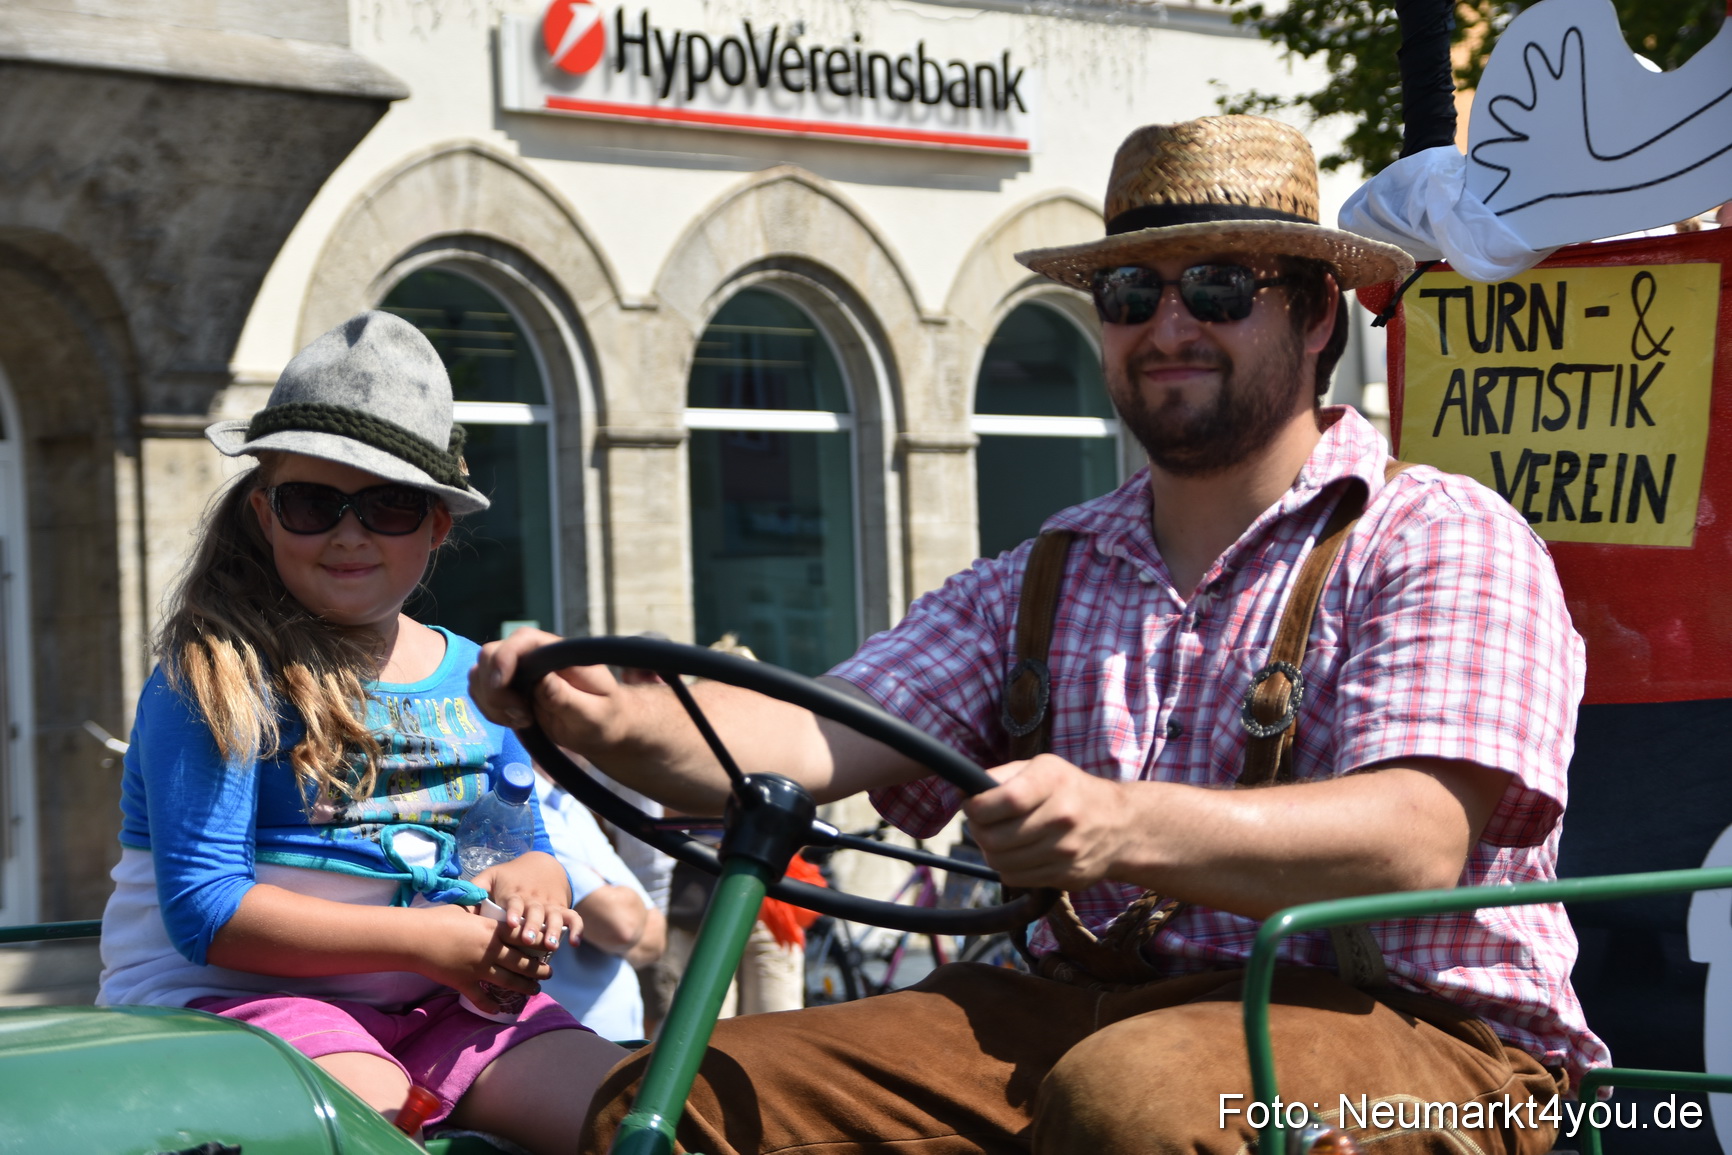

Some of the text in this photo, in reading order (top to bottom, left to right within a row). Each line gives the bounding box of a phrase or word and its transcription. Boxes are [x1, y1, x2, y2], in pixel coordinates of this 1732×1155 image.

[616, 6, 1028, 113] HypoVereinsbank
[1419, 280, 1567, 356] TURN
[1631, 270, 1675, 361] &
[1432, 361, 1666, 437] ARTISTIK
[1489, 448, 1677, 525] VEREIN
